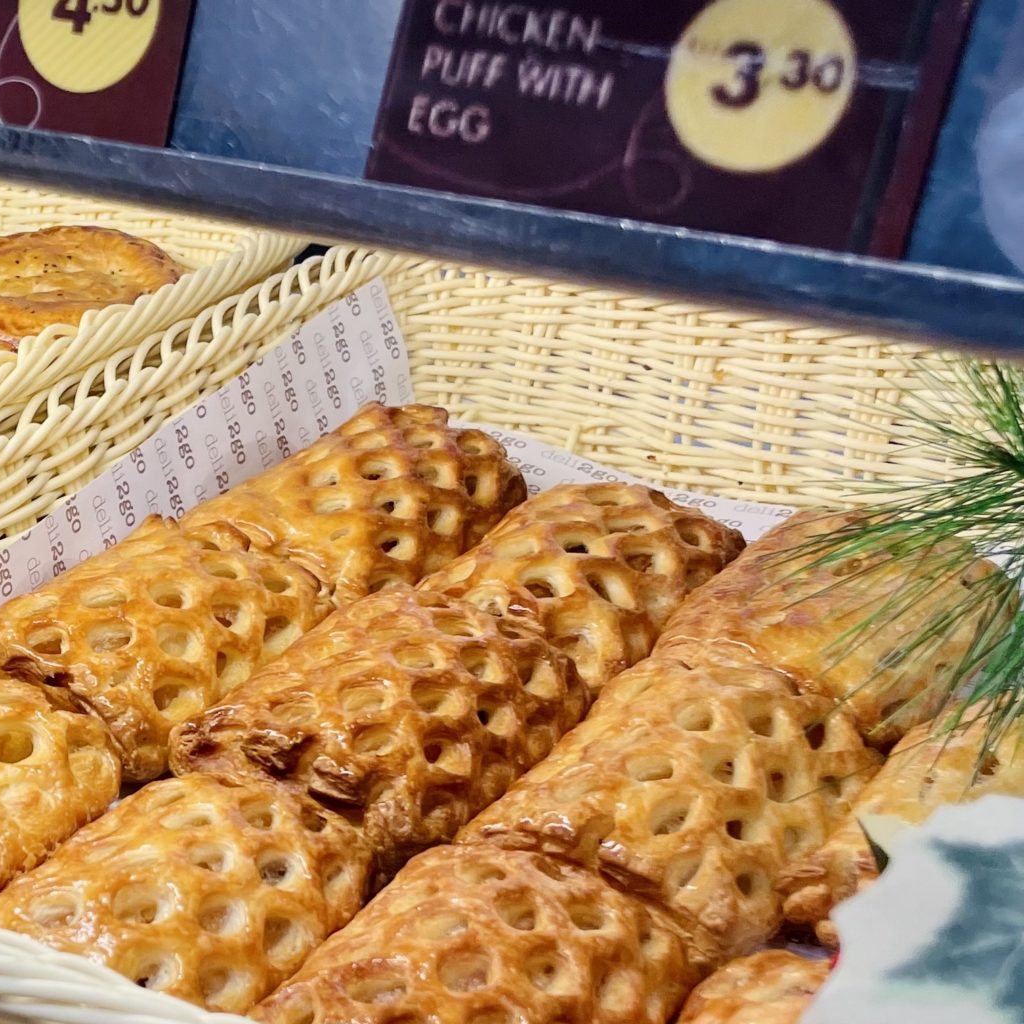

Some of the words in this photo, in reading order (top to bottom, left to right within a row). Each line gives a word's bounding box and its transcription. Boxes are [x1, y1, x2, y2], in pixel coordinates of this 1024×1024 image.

[434, 0, 602, 50] CHICKEN
[422, 44, 506, 88] PUFF
[518, 55, 614, 110] WITH
[692, 37, 845, 110] 3.30
[407, 93, 491, 142] EGG
